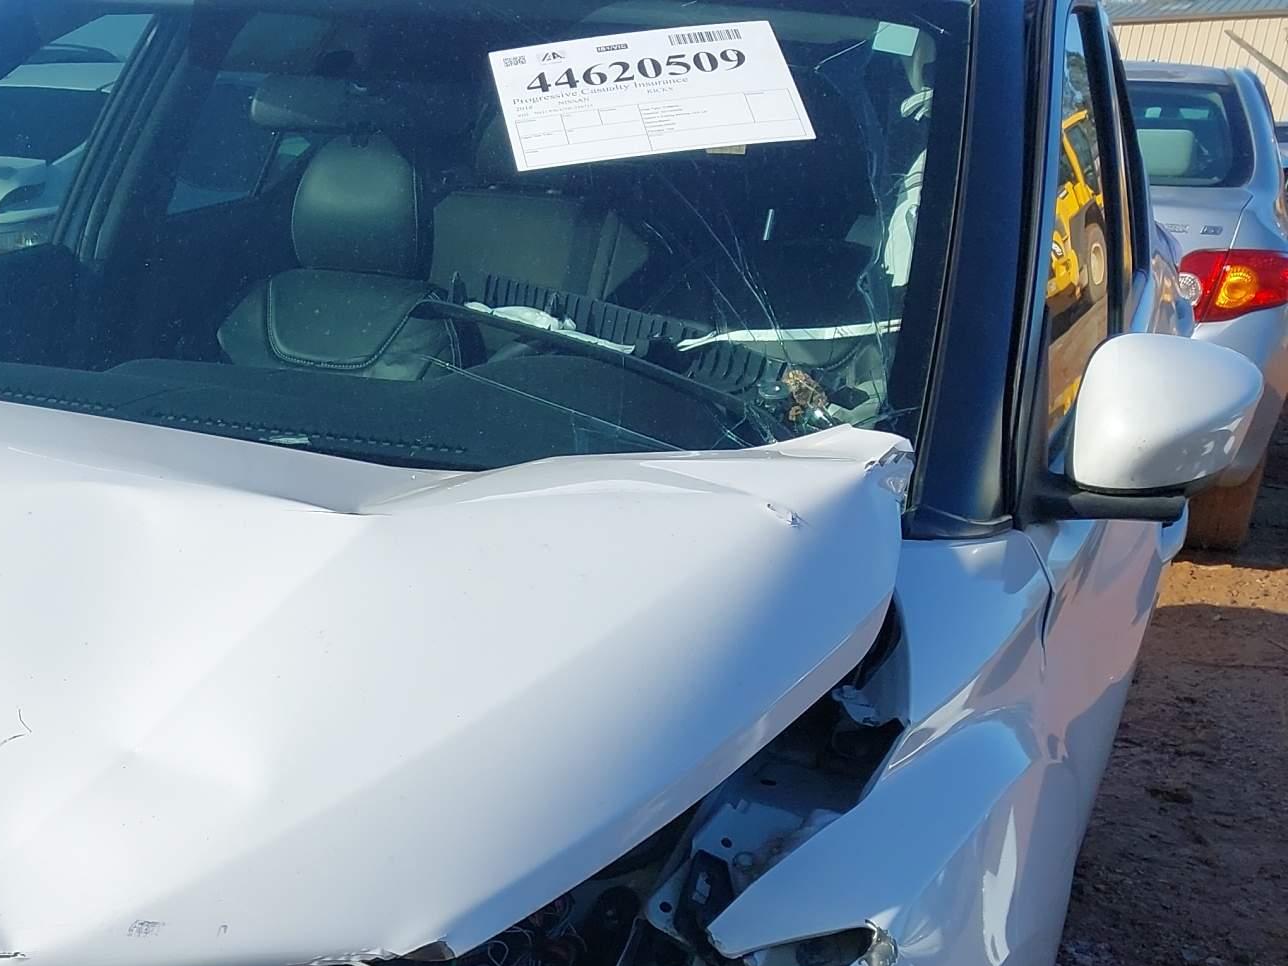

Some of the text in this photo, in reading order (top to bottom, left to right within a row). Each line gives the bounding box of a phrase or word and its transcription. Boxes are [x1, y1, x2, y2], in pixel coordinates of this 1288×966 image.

[526, 48, 746, 93] 44620509
[513, 77, 689, 105] Progressive Casualty Insurance
